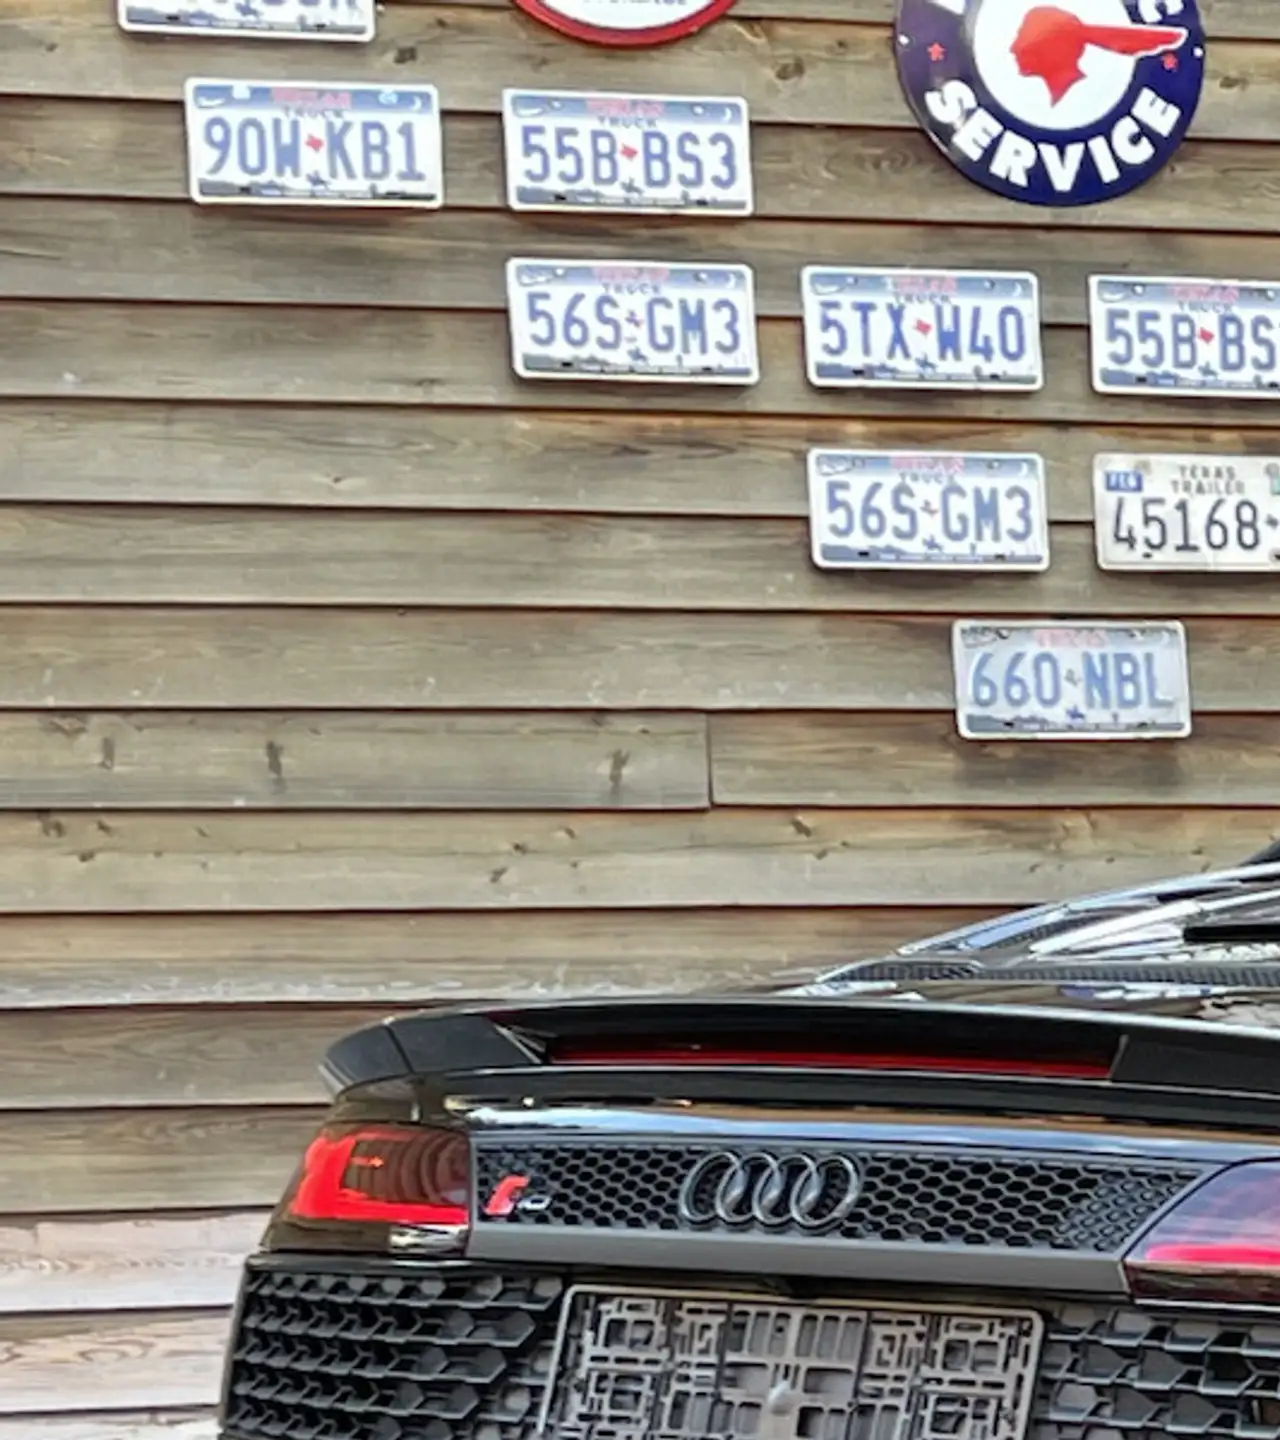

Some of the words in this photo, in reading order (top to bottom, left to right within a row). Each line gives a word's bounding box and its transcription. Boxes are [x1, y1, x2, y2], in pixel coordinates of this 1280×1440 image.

[204, 116, 301, 177] 90W
[326, 120, 426, 181] KB1
[521, 125, 619, 186] 55B
[642, 131, 737, 189] BS3
[924, 80, 1183, 192] SERVICE
[526, 291, 622, 351] 56S
[646, 297, 741, 355] GM3
[819, 300, 912, 361] 5TX
[935, 304, 1025, 363] W40
[1105, 307, 1198, 370] 55B
[825, 480, 918, 540] 56S
[940, 484, 1033, 543] GM3
[1113, 496, 1260, 553] 45168
[971, 651, 1062, 709] 660
[1082, 651, 1176, 710] NBL
